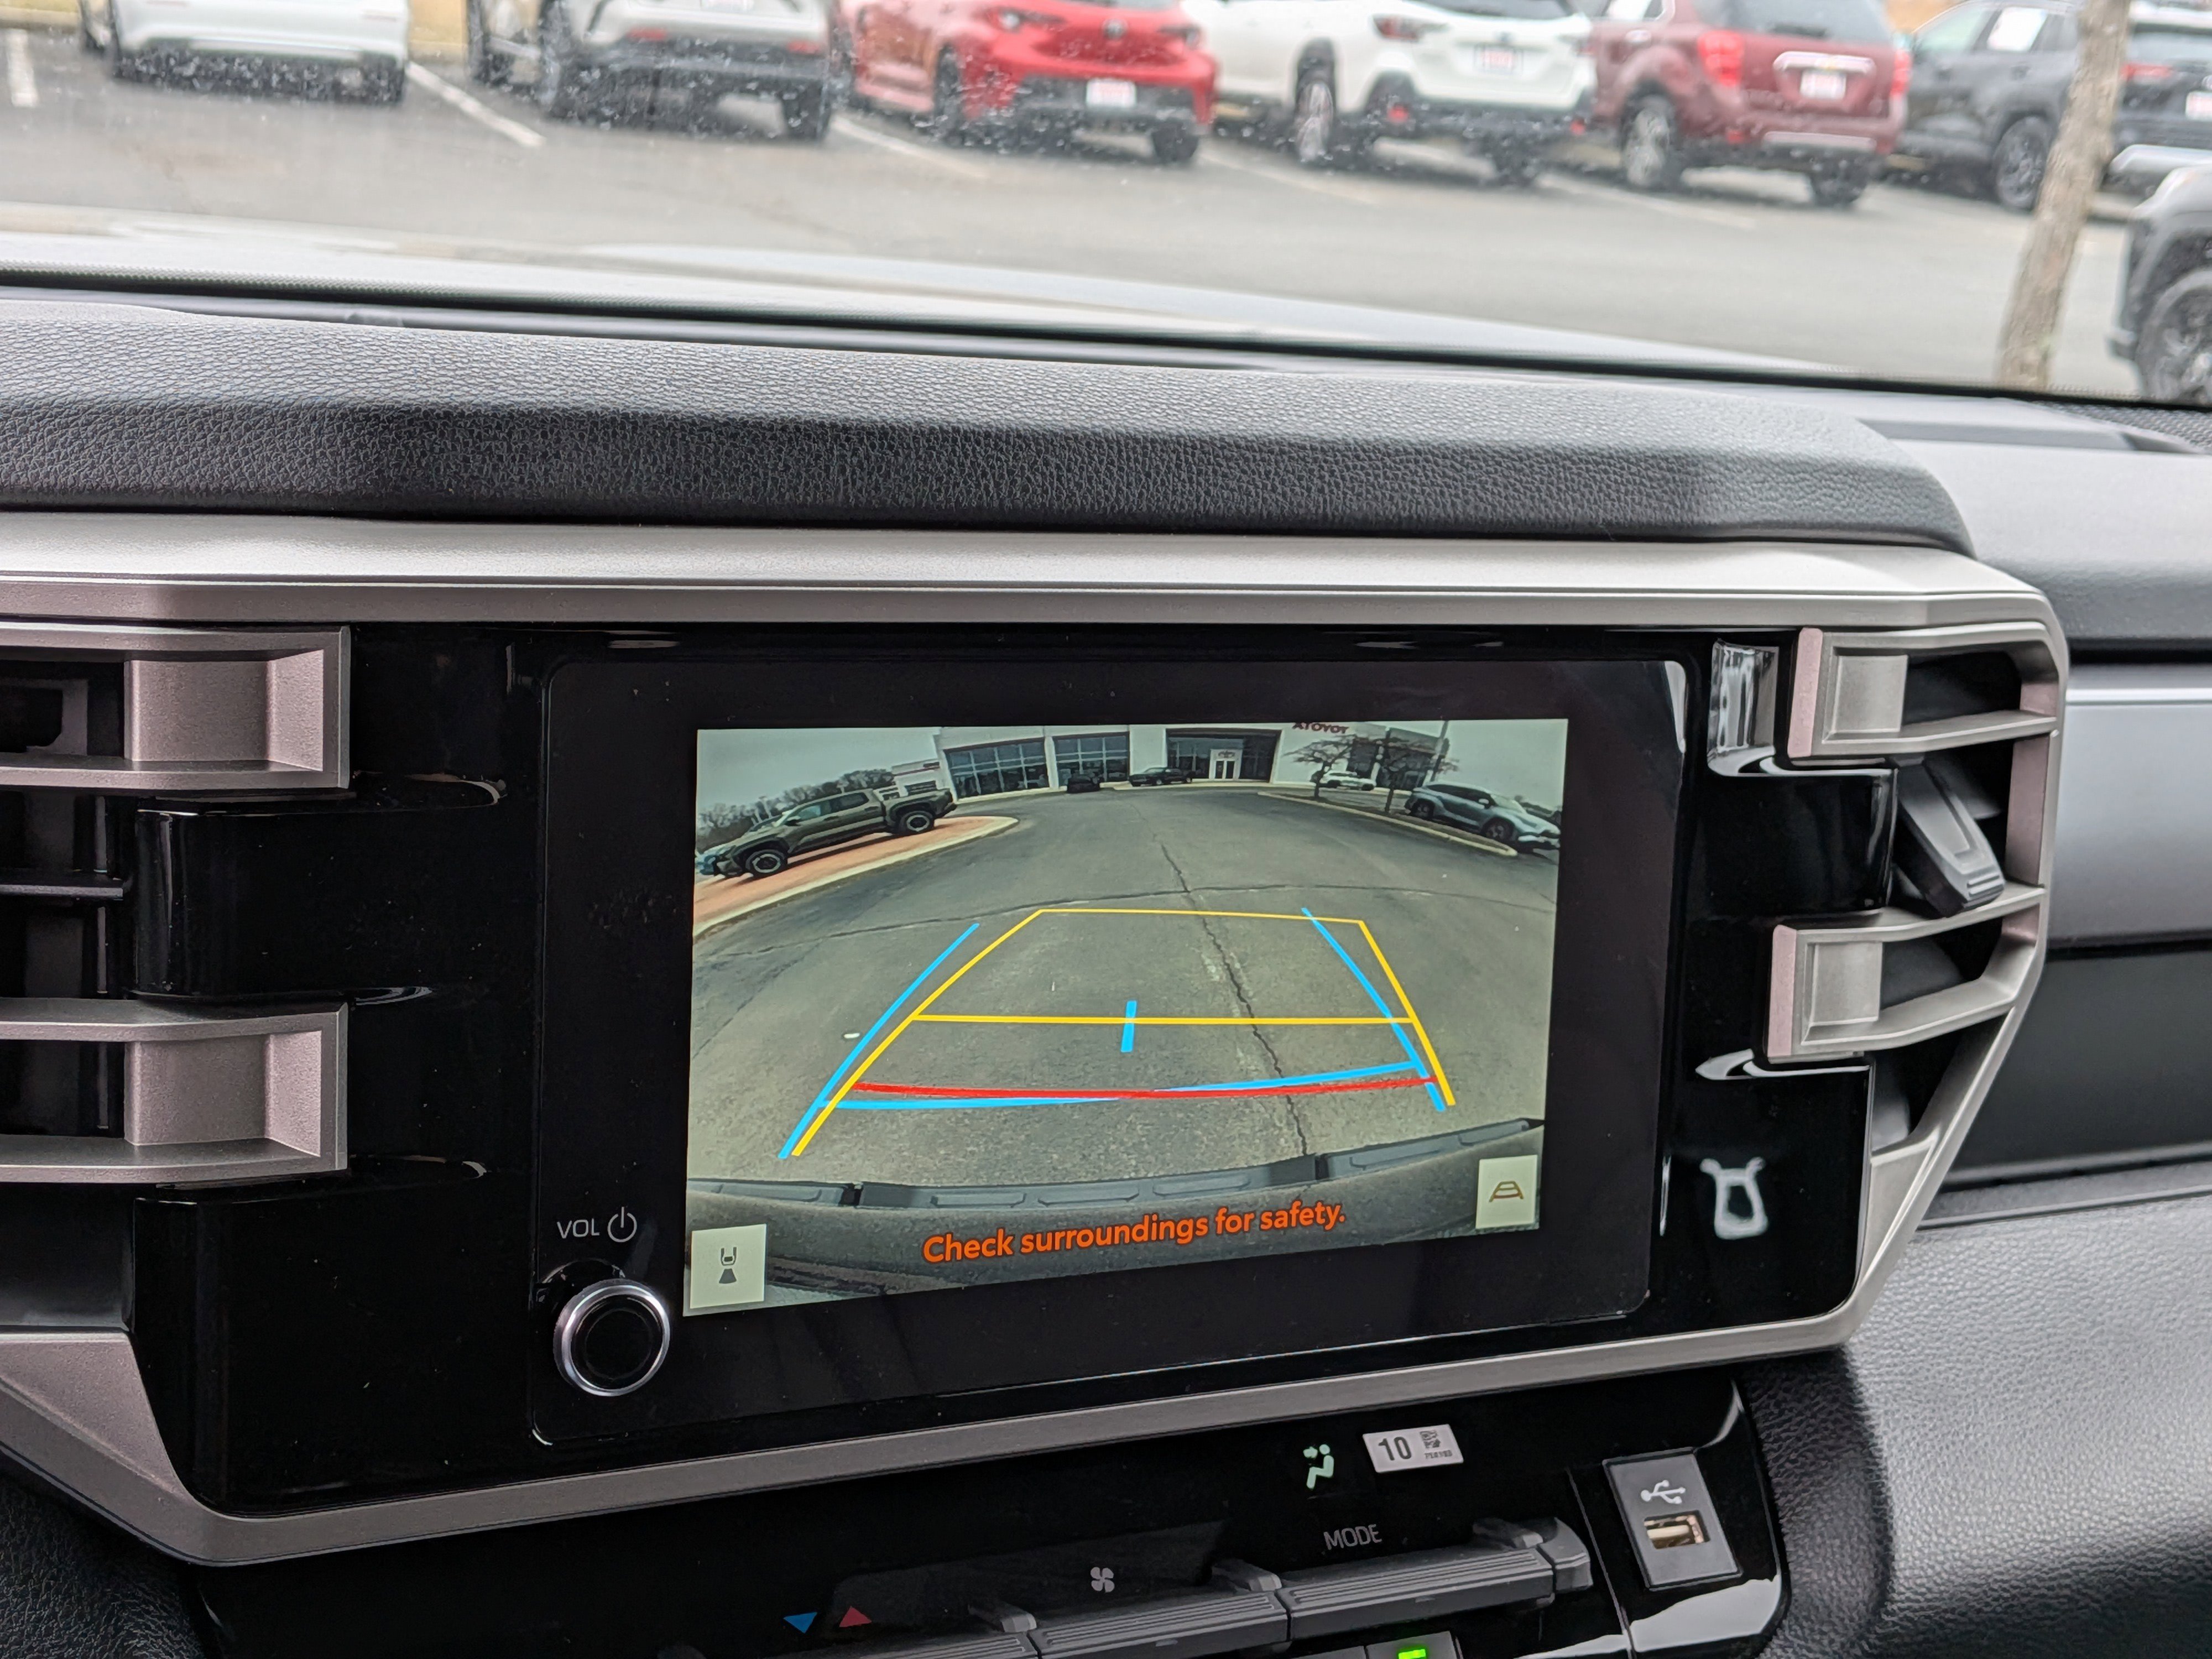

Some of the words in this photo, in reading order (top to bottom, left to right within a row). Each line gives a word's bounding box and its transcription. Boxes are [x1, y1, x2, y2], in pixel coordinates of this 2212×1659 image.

[556, 1218, 600, 1239] VOL
[923, 1228, 1014, 1262] Check
[1020, 1214, 1209, 1253] surroundings
[1215, 1207, 1255, 1234] for
[1260, 1200, 1345, 1230] safety.
[1378, 1436, 1412, 1461] 10
[1323, 1524, 1383, 1550] MODE
